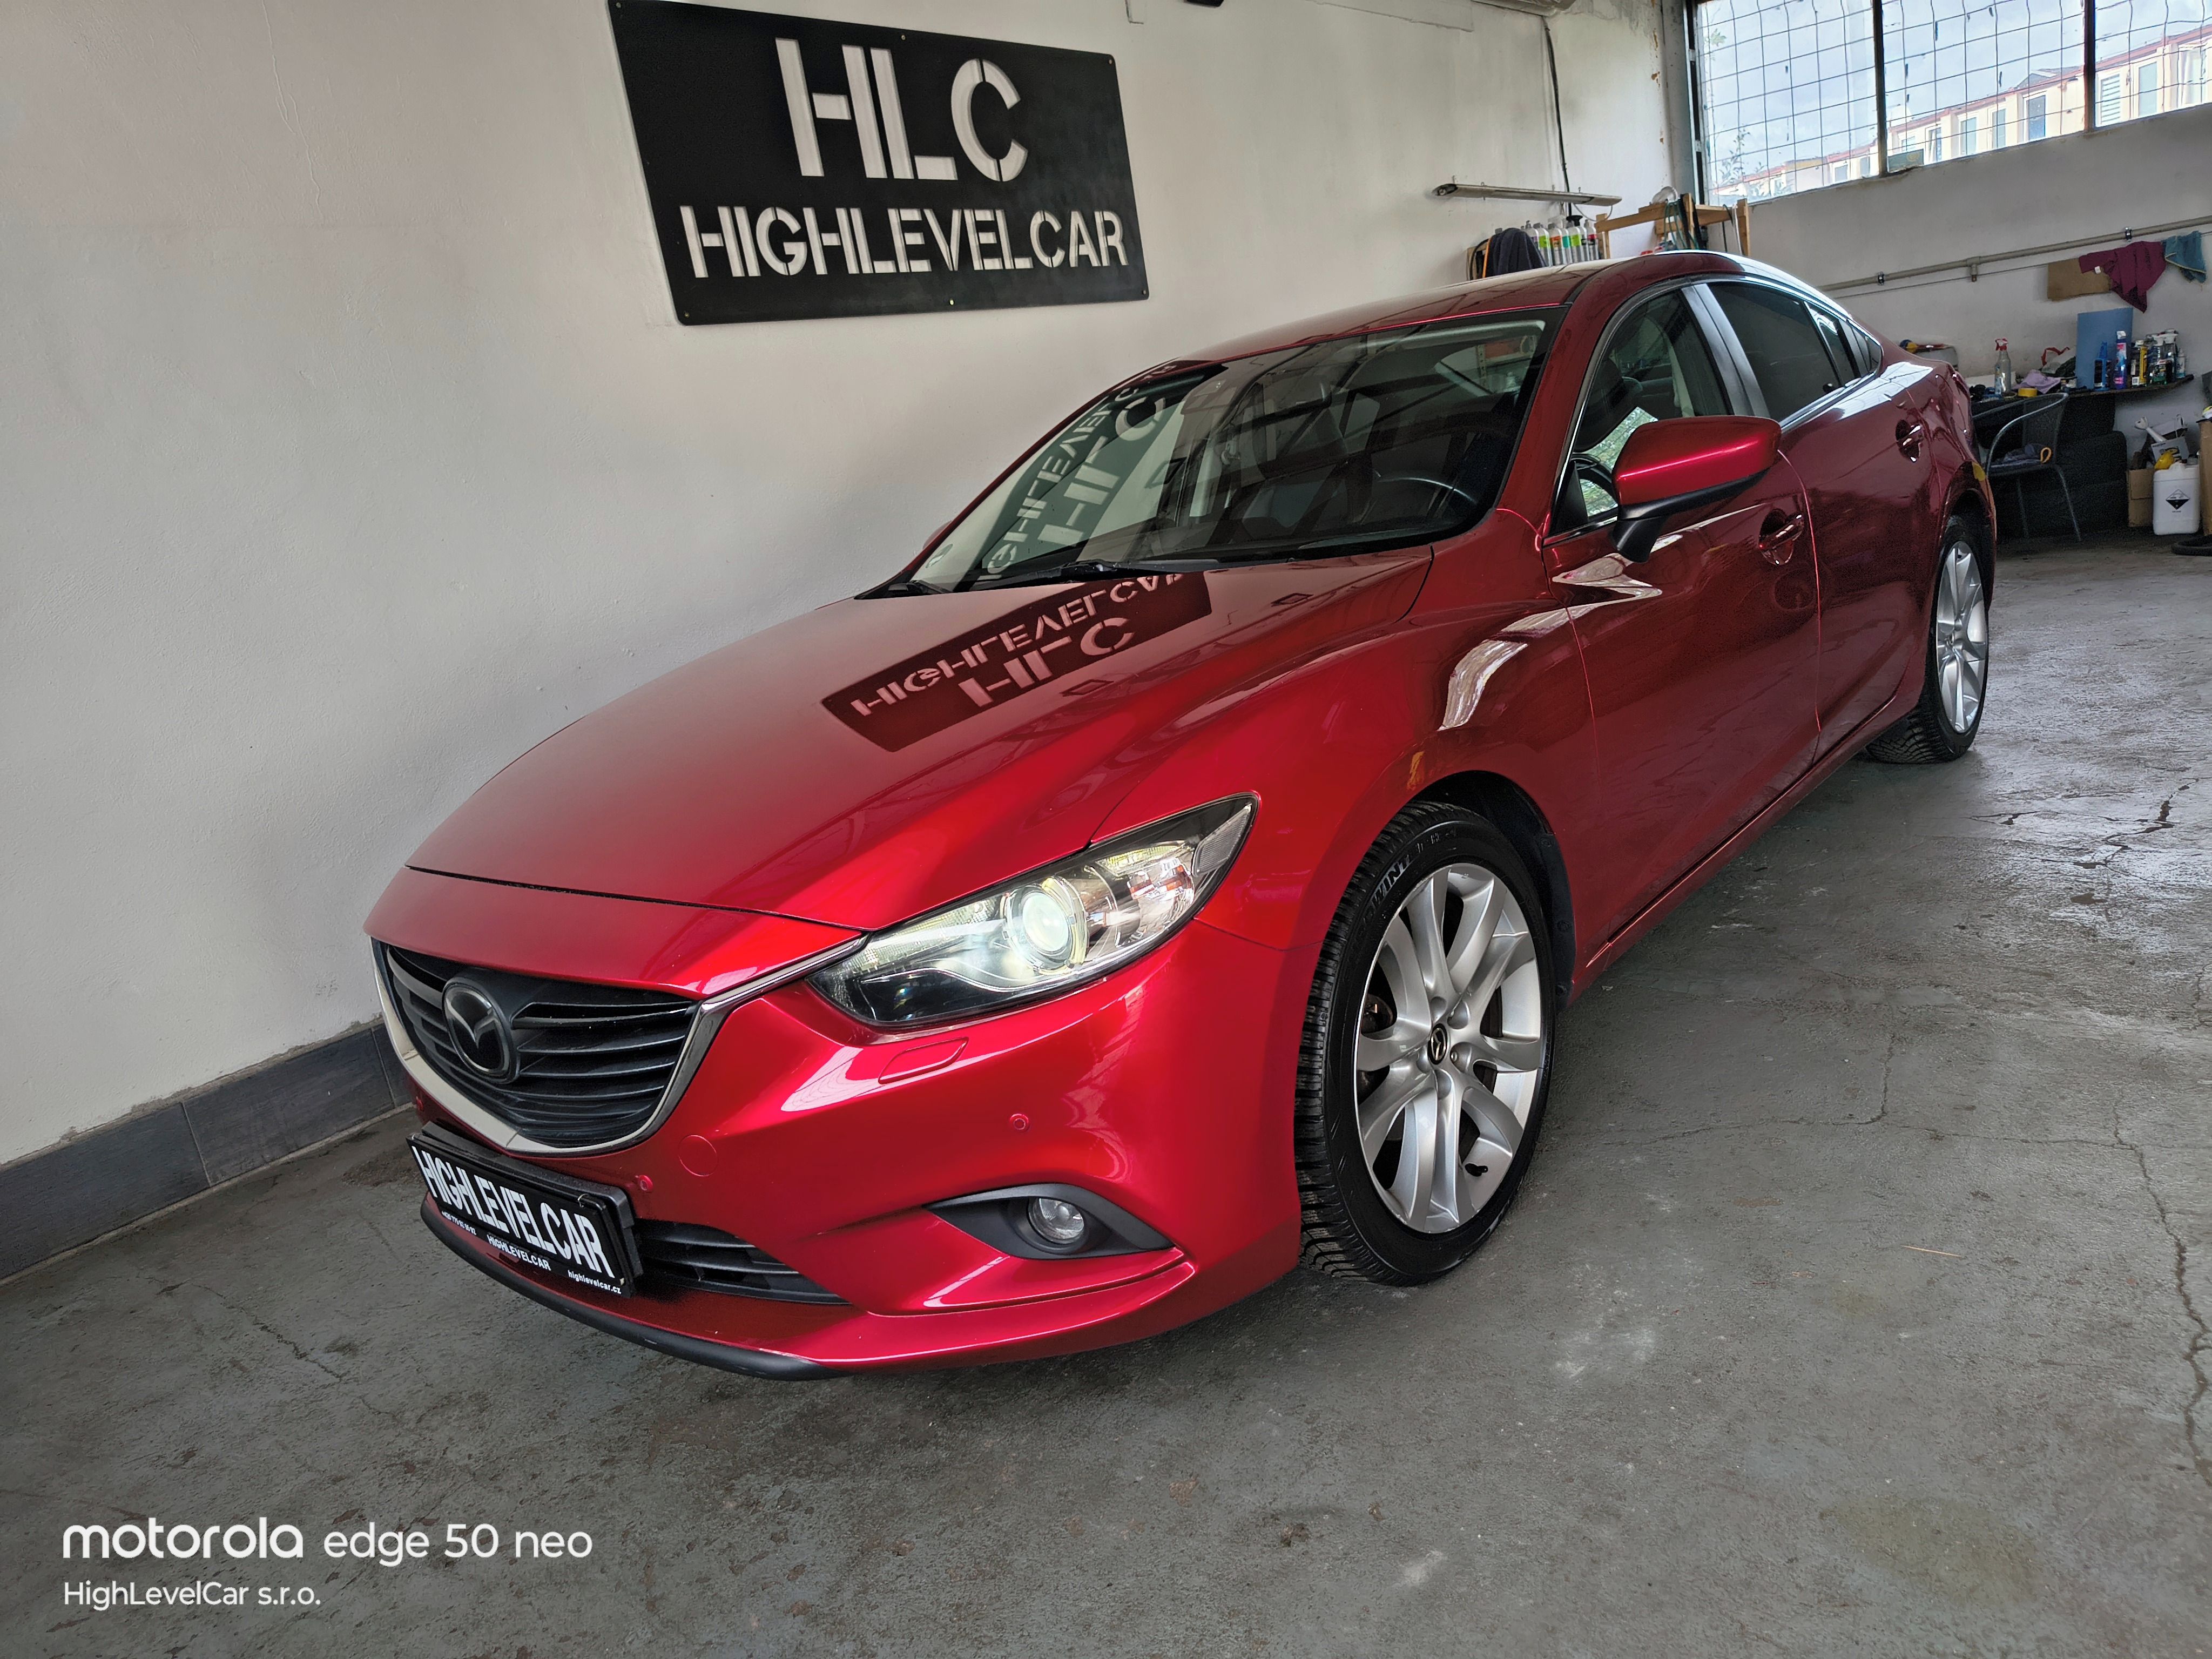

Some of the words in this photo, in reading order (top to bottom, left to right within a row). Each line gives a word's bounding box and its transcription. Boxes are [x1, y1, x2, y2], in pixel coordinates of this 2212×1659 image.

[775, 37, 1028, 182] HLC
[680, 205, 1129, 279] HIGHLEVELCAR
[412, 1145, 615, 1278] HIGHLEVELCAR
[488, 1235, 552, 1271] HIGHLEVELCAR
[567, 1269, 622, 1294] highlevelcar.cz
